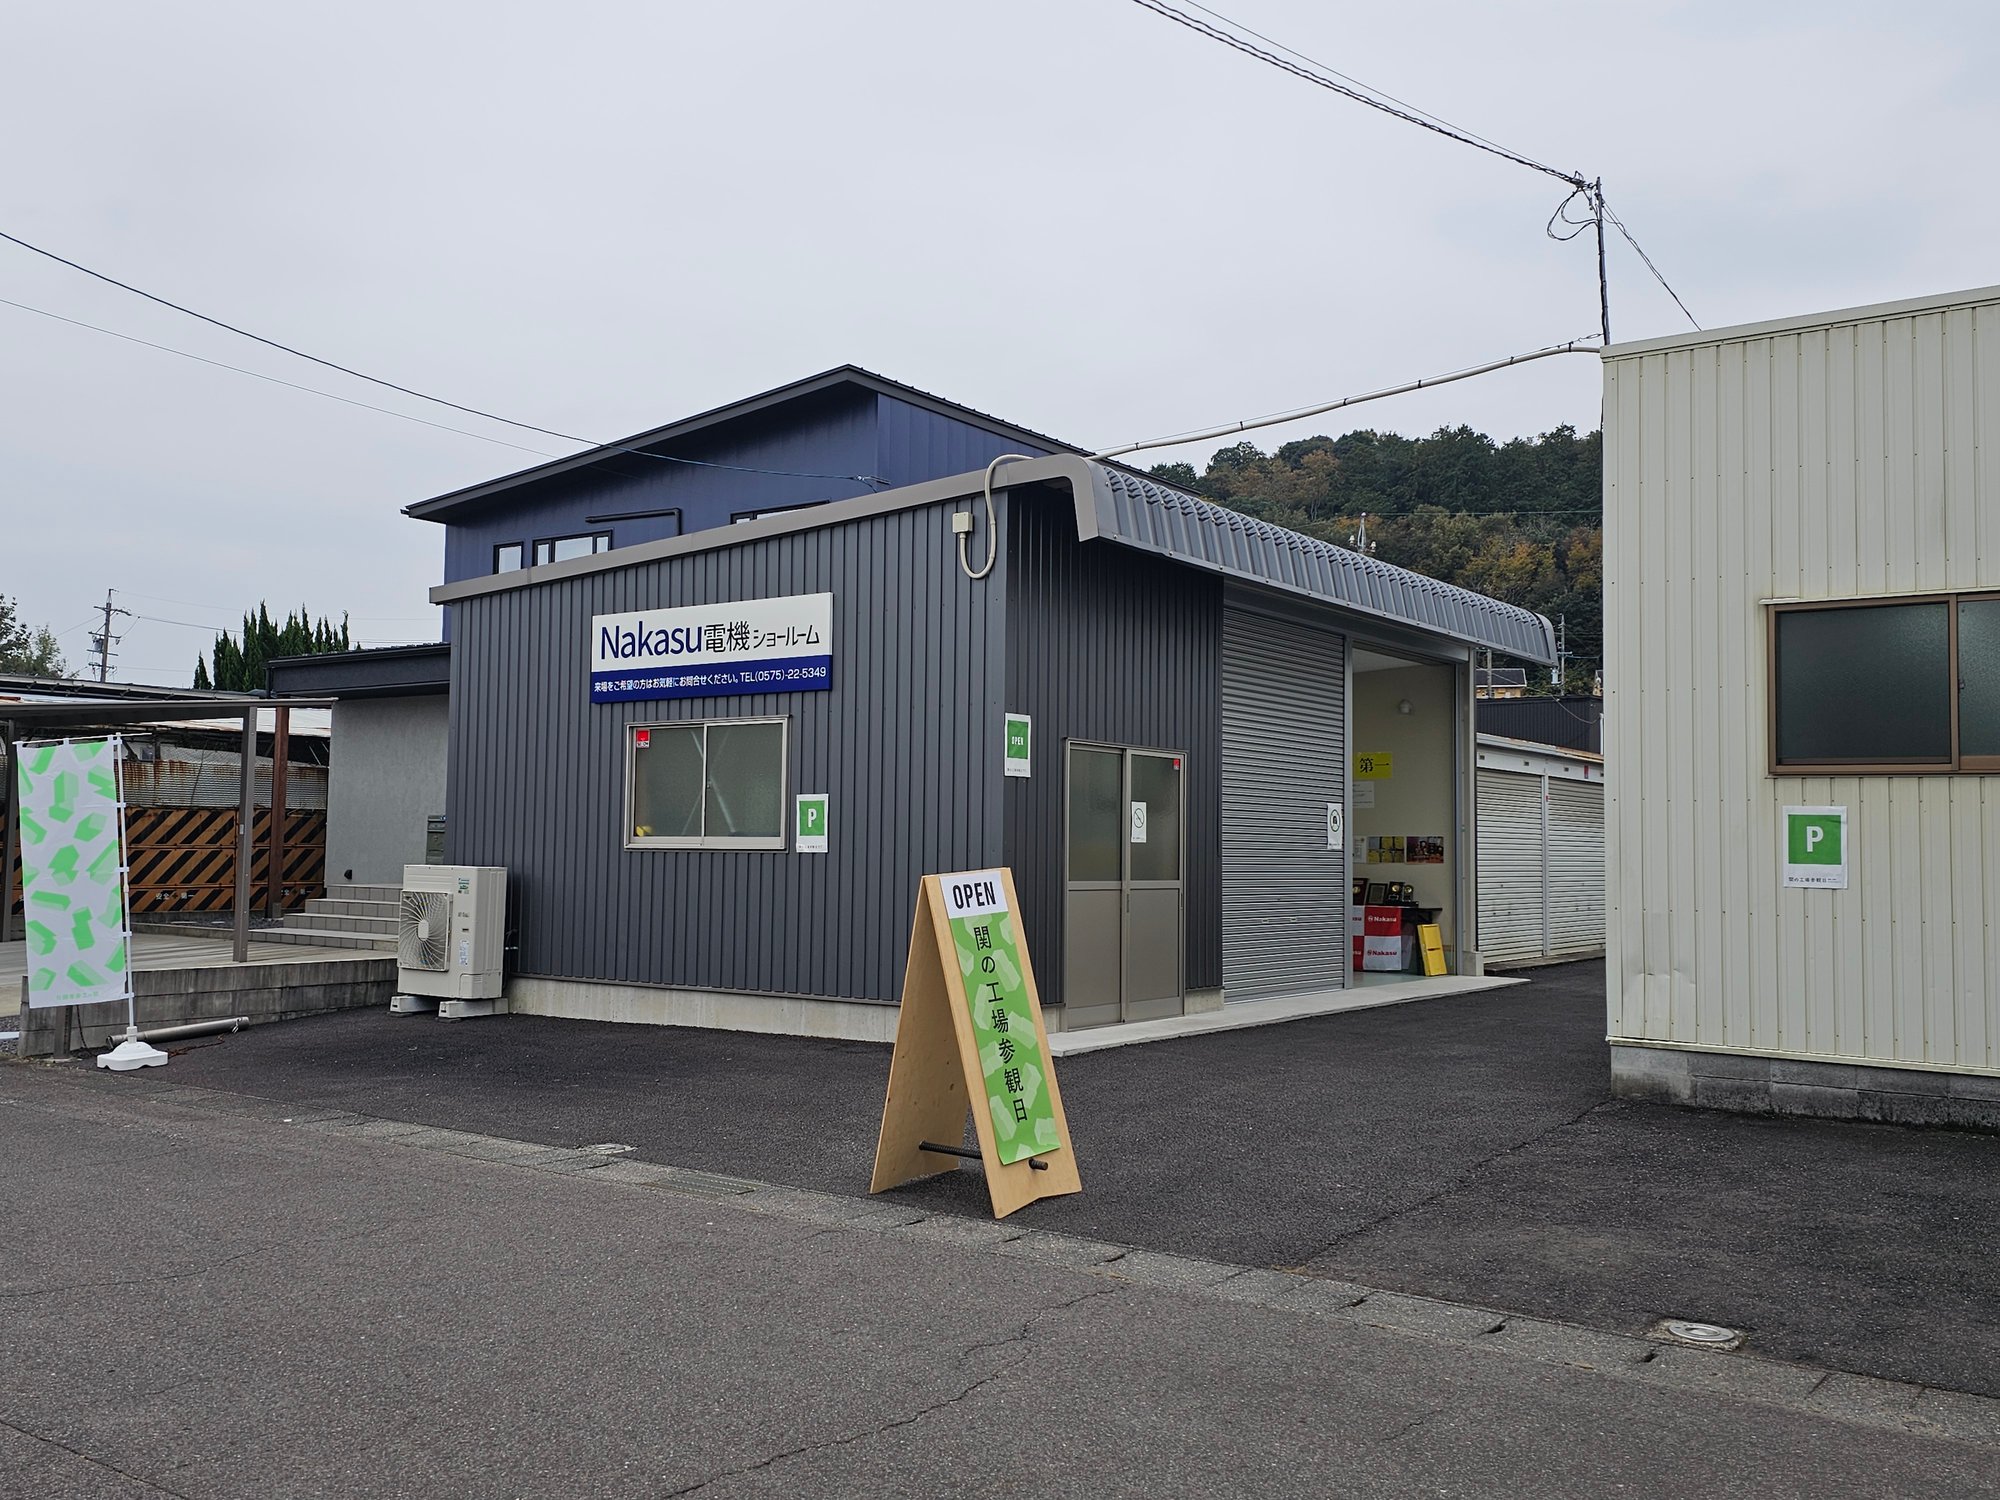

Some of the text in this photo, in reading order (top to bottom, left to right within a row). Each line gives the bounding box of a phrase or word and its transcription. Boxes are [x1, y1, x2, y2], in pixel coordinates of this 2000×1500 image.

[1011, 736, 1024, 746] OPEN
[1360, 757, 1389, 773] 第一
[807, 808, 818, 828] P
[1806, 825, 1824, 853] P
[952, 881, 996, 910] OPEN
[974, 926, 1028, 1123] 関の工場参観日
